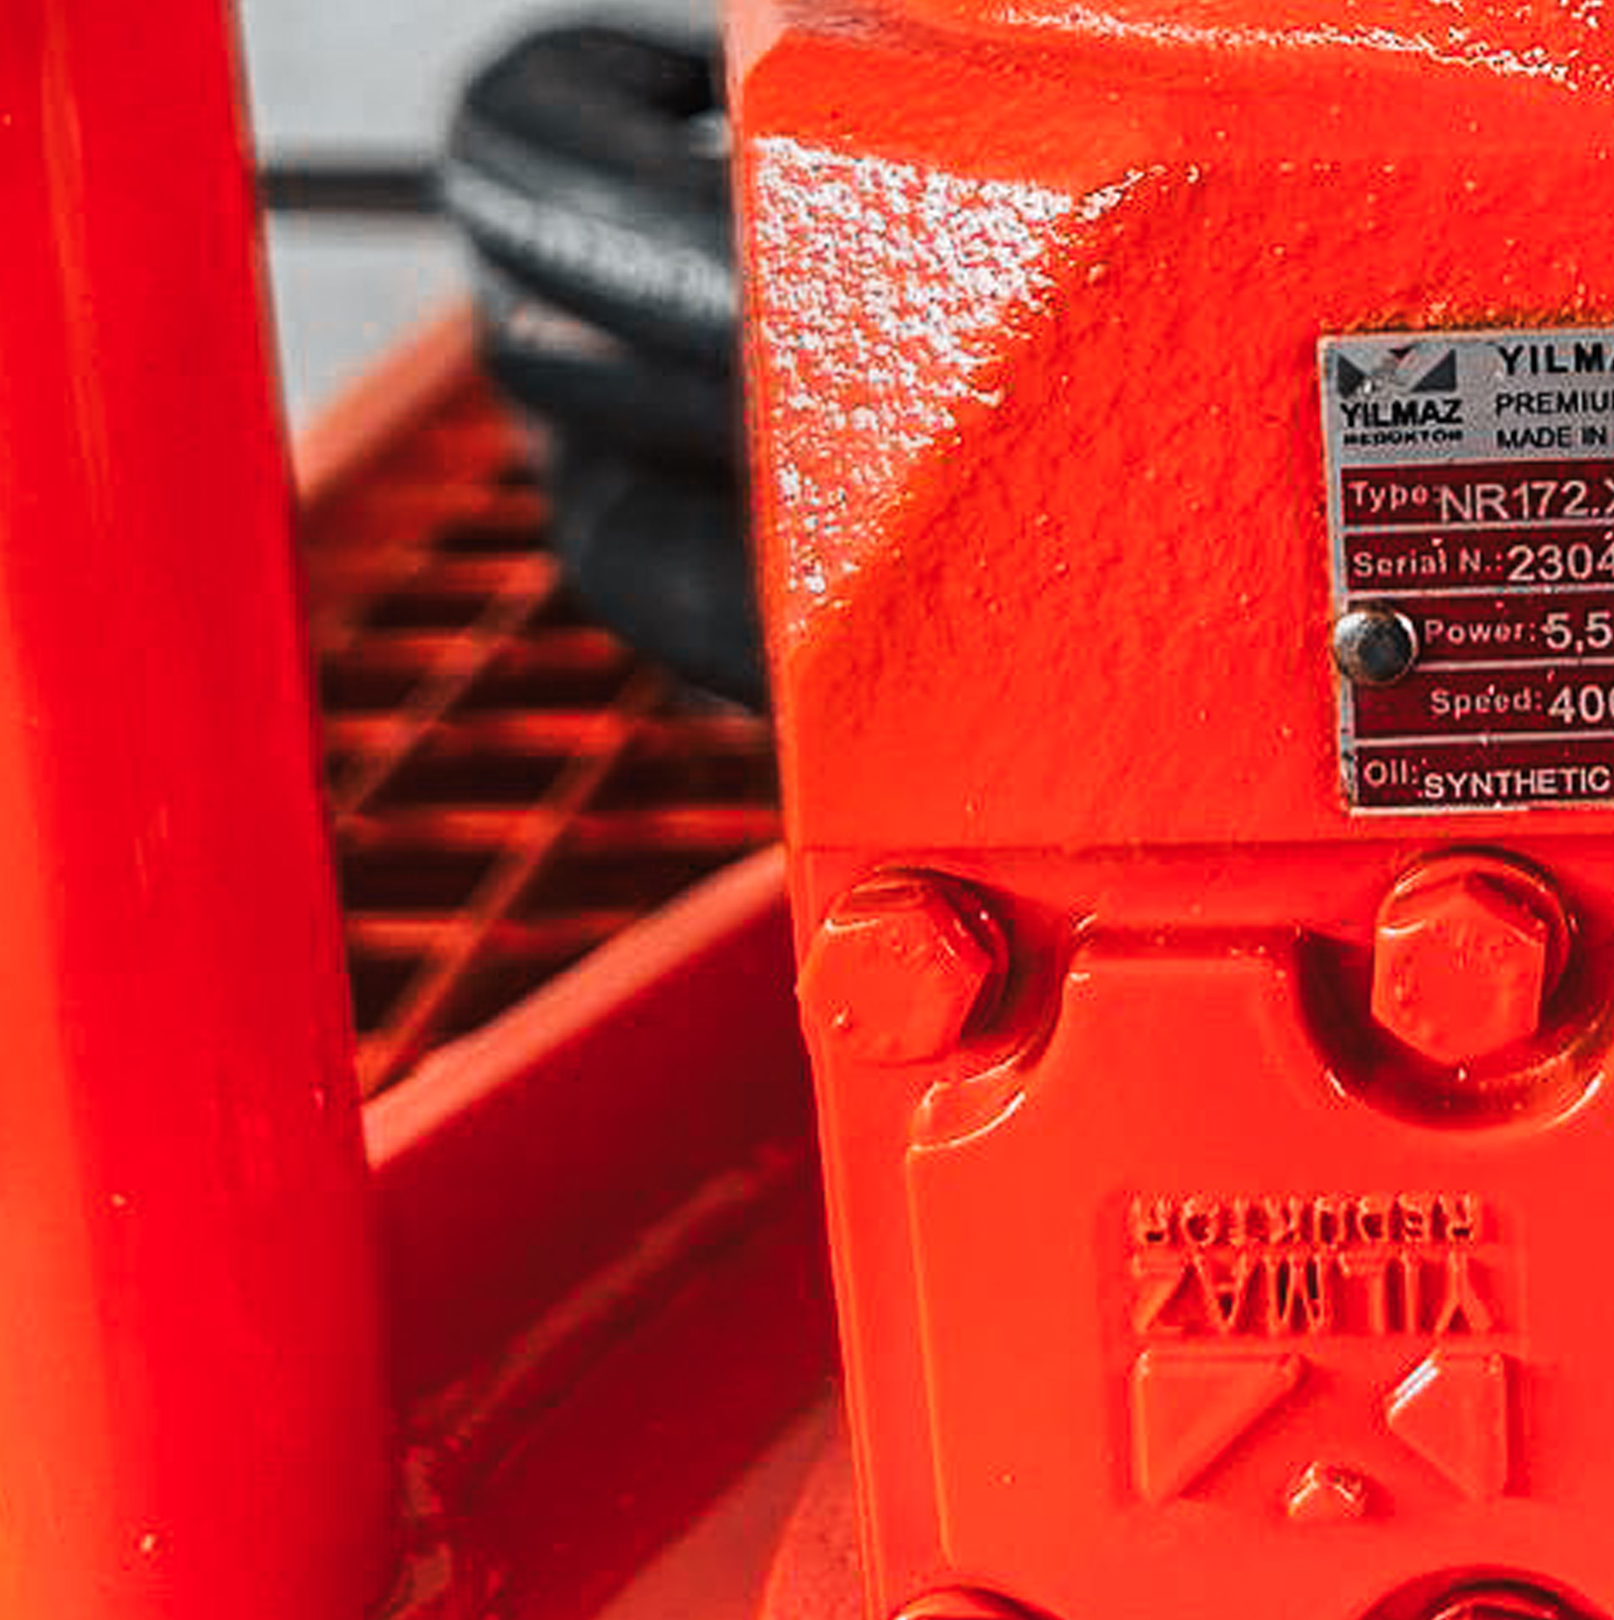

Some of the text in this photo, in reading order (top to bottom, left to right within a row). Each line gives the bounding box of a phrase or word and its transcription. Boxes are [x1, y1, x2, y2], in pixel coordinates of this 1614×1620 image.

[1341, 398, 1463, 429] YILMAZ
[1496, 428, 1572, 450] MADE
[1582, 426, 1607, 447] IN
[1352, 547, 1448, 578] Serial
[1424, 619, 1537, 644] Power:
[1545, 611, 1614, 655] 5,5
[1430, 686, 1544, 720] Speed:
[1363, 759, 1419, 788] Oil:
[1423, 765, 1613, 799] SYNTHETIC
[1130, 1250, 1493, 1334] YILMAZ
